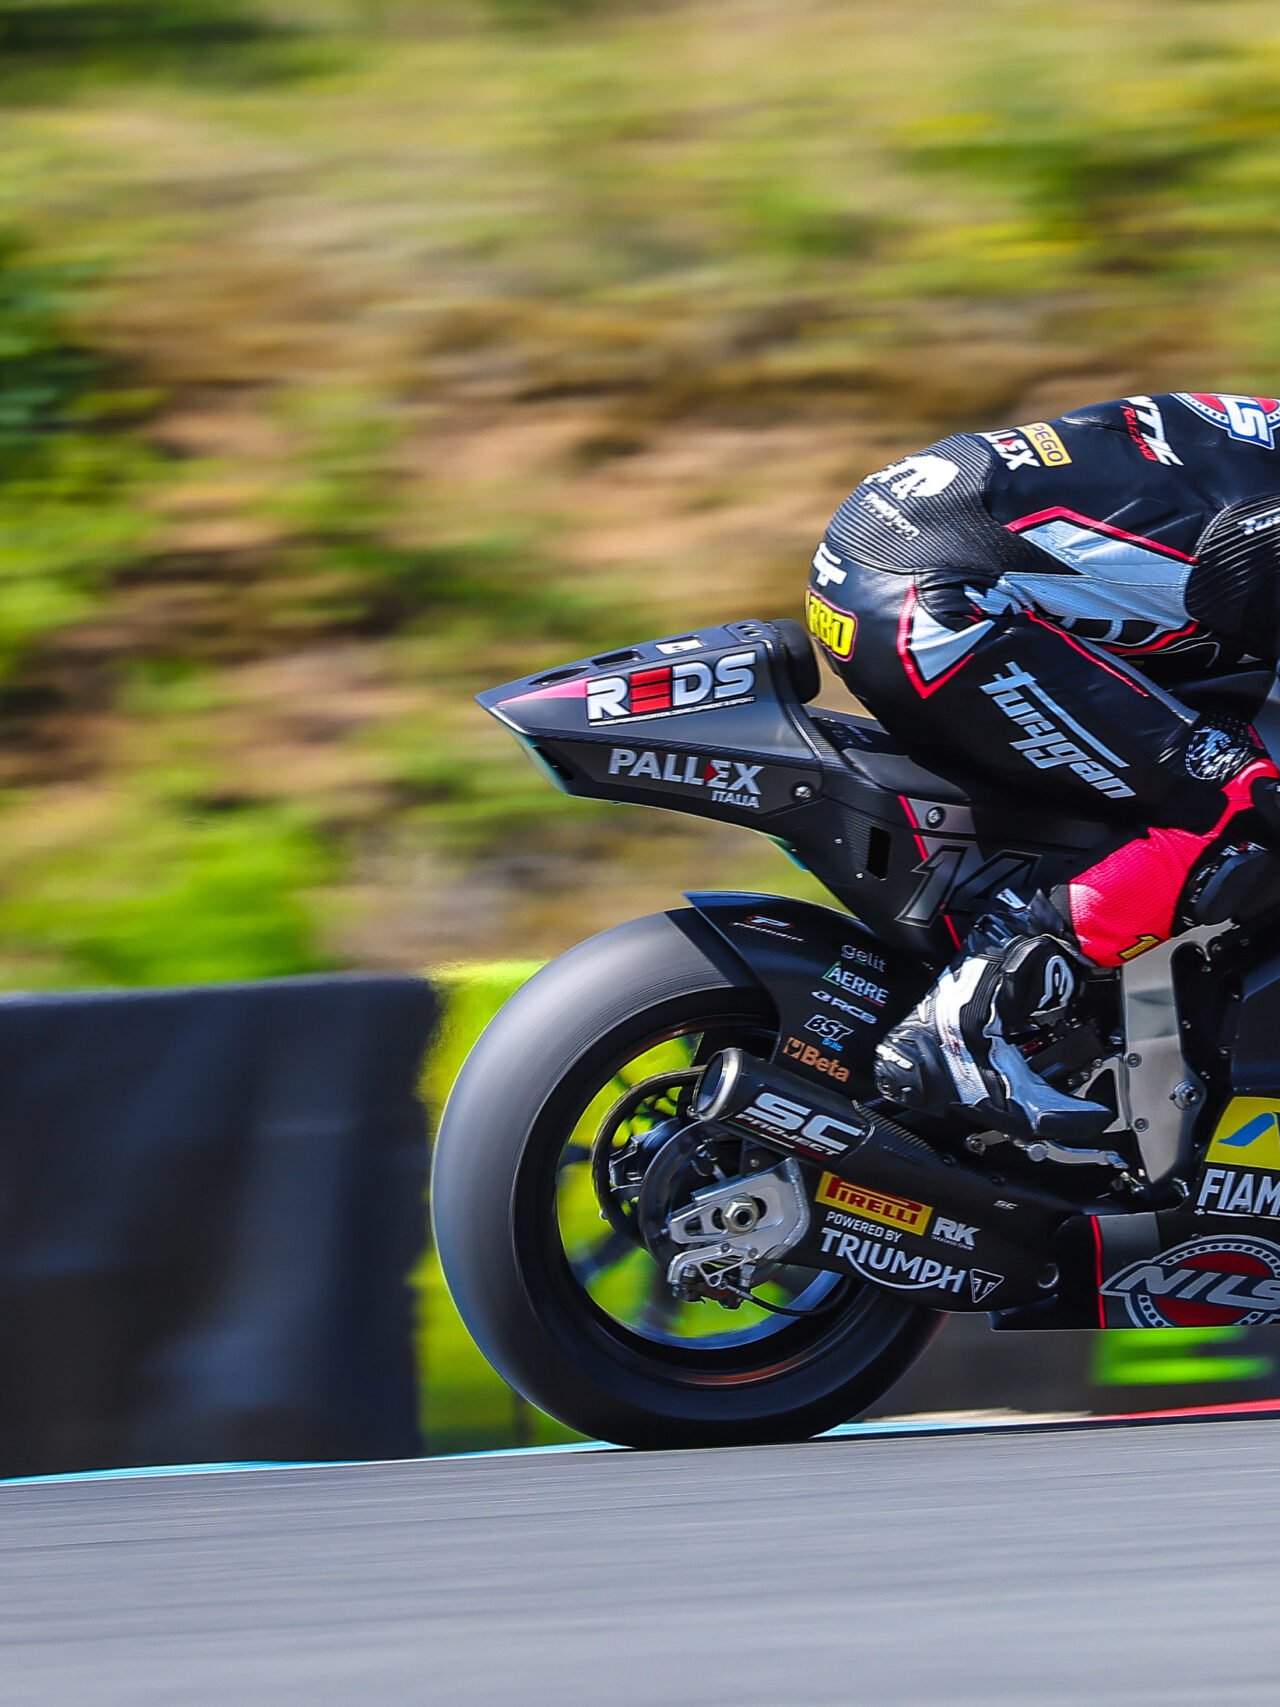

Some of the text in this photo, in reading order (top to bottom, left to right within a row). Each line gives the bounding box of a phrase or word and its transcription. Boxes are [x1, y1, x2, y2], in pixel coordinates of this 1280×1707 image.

[587, 652, 757, 720] REDS
[608, 748, 765, 795] PALLEX
[711, 790, 761, 809] ITALIA
[841, 945, 888, 973] gelit
[828, 967, 890, 1005] AERRE
[804, 1014, 855, 1042] BST
[800, 1045, 851, 1083] Beta
[735, 1113, 841, 1156] PROJECT
[743, 1092, 863, 1152] SC
[825, 1176, 923, 1226] PIRELLI
[825, 1211, 904, 1244] POWERED BY
[932, 1216, 982, 1247] RK
[820, 1226, 967, 1294] TRIUMPH
